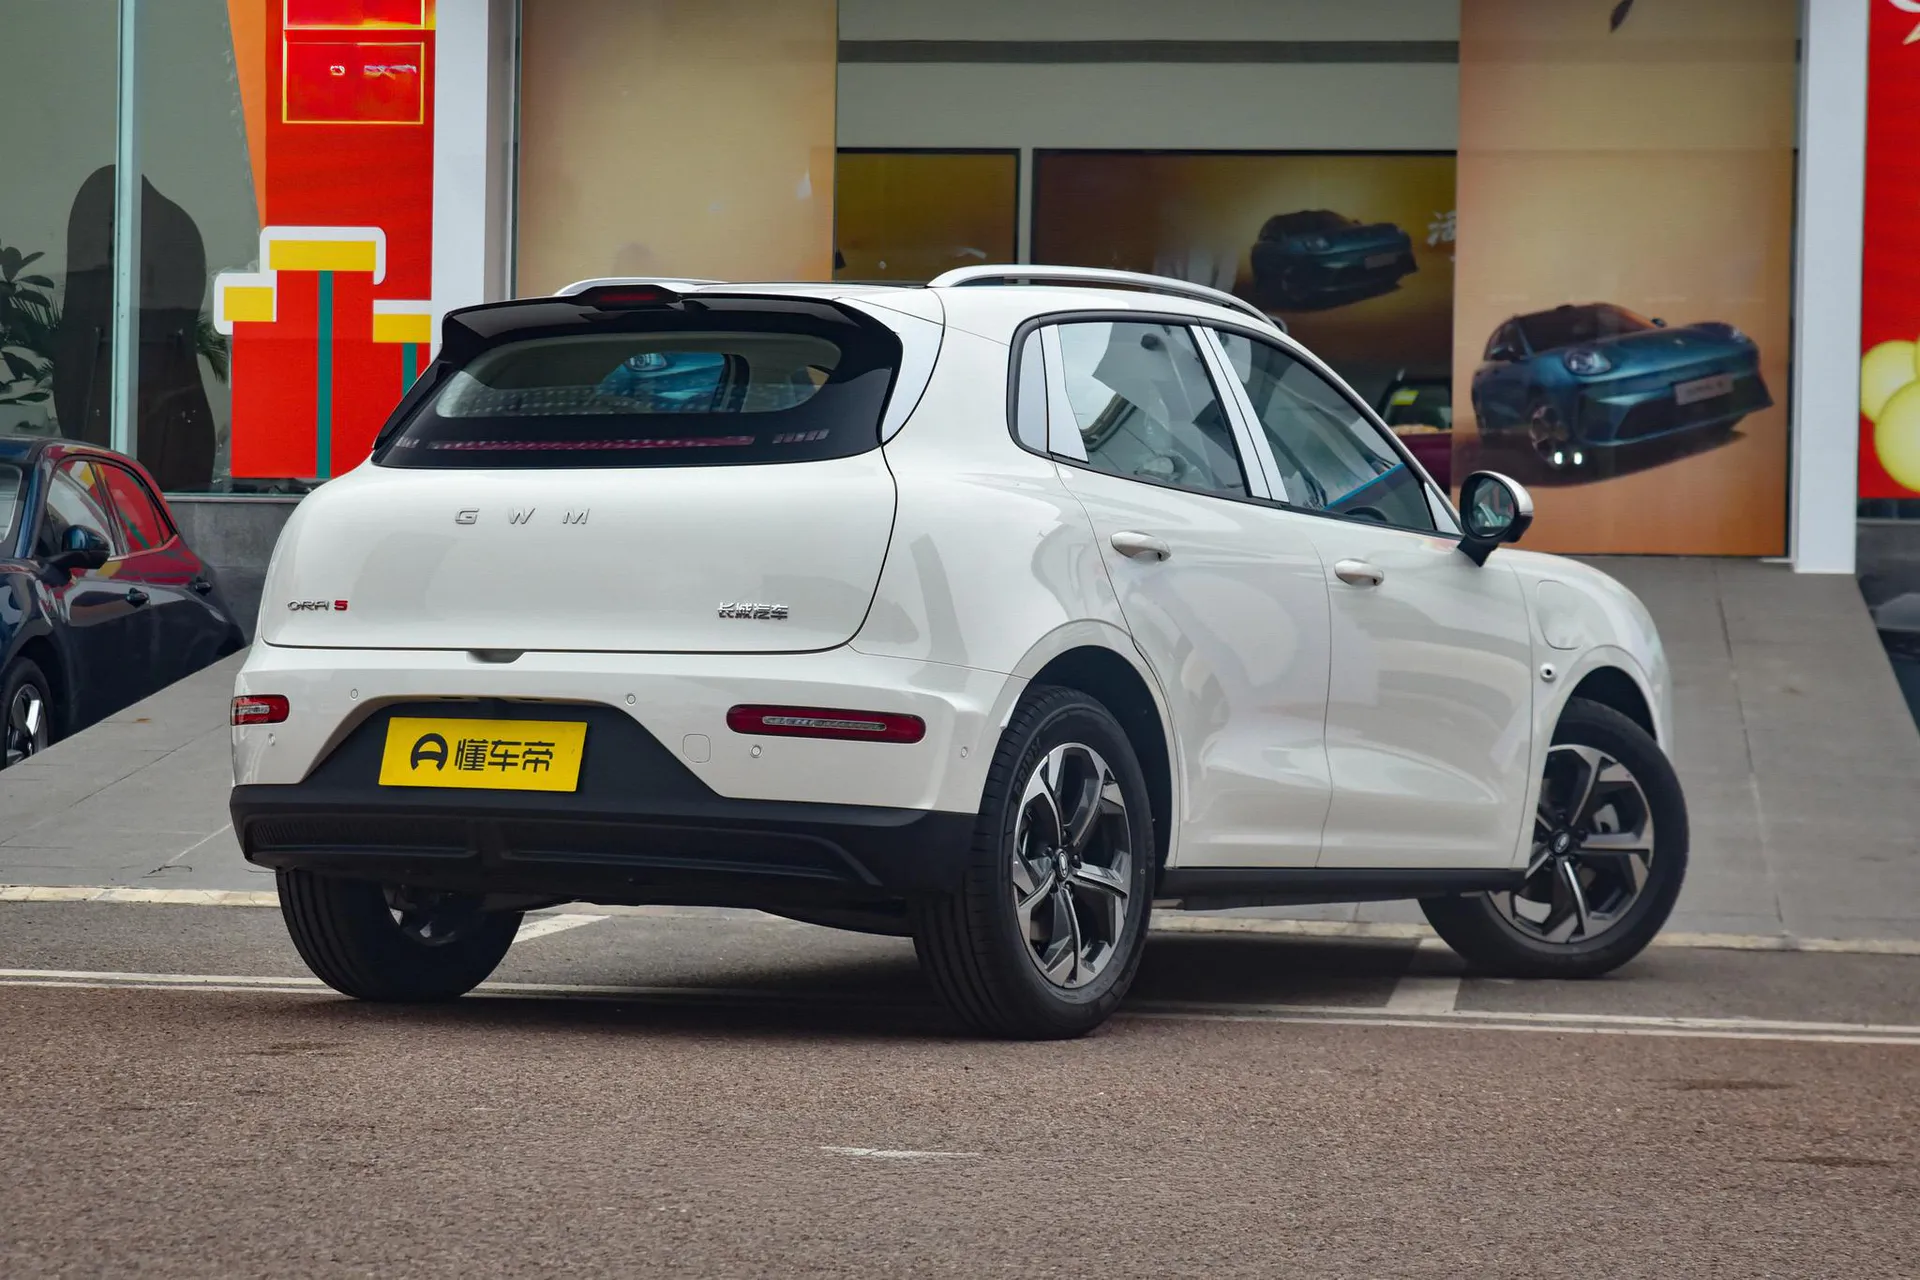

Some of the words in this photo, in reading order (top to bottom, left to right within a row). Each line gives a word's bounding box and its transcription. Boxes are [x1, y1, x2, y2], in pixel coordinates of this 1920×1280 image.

[287, 601, 330, 611] ORA
[717, 602, 789, 620] 长城汽车
[454, 738, 556, 773] 懂车帝
